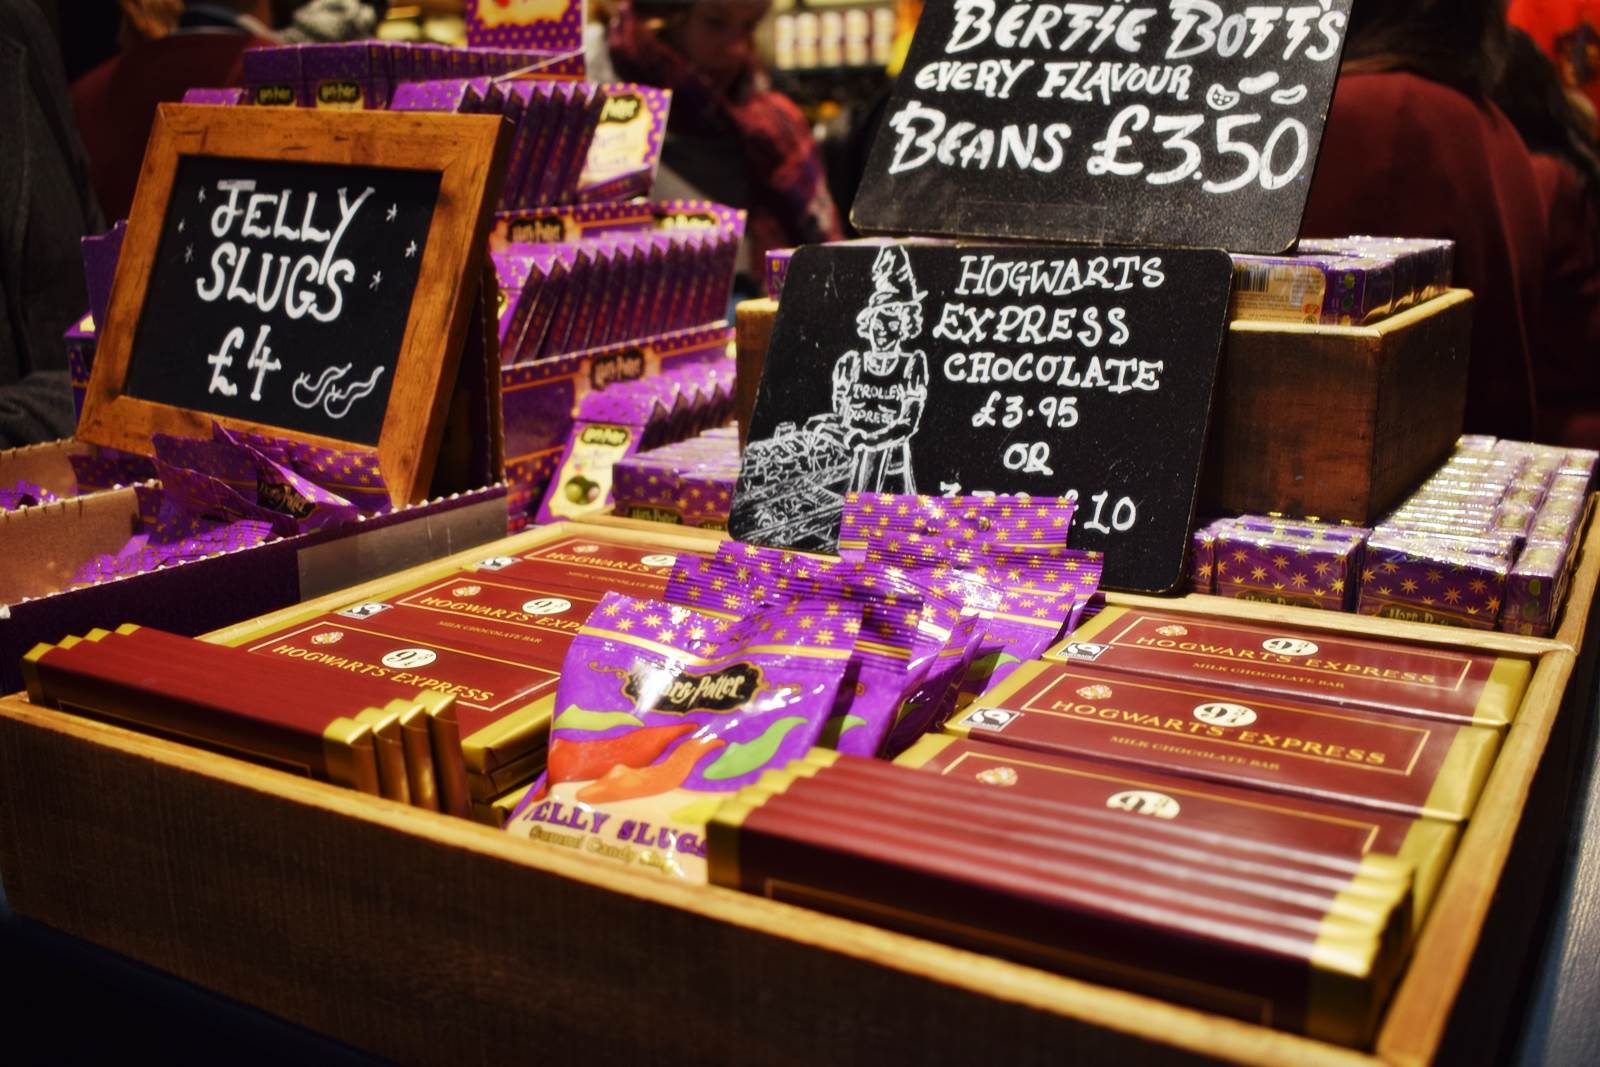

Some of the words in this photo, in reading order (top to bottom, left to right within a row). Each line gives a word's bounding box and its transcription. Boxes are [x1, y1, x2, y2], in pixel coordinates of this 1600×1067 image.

[945, 0, 1158, 54] BERTIE
[914, 59, 1034, 93] EVERY
[1037, 61, 1193, 105] FLAVOUR
[889, 100, 1072, 174] BEANS
[1087, 104, 1308, 193] £3.50
[210, 180, 375, 286] JELLY
[196, 243, 355, 323] SLUGS
[954, 255, 1165, 297] HOGWARTS
[932, 303, 1130, 348] EXPRESS
[207, 325, 281, 401] £4
[943, 352, 1164, 394] CHOCOLATE
[1002, 441, 1055, 477] OR
[420, 596, 533, 622] HOGWARTS
[272, 644, 391, 678] HOGWARTS
[1136, 637, 1293, 664] HOGWARTS
[1304, 657, 1437, 685] EXPRESS
[1050, 699, 1226, 738] HOGWARTS
[1237, 729, 1387, 765] EXPRESS
